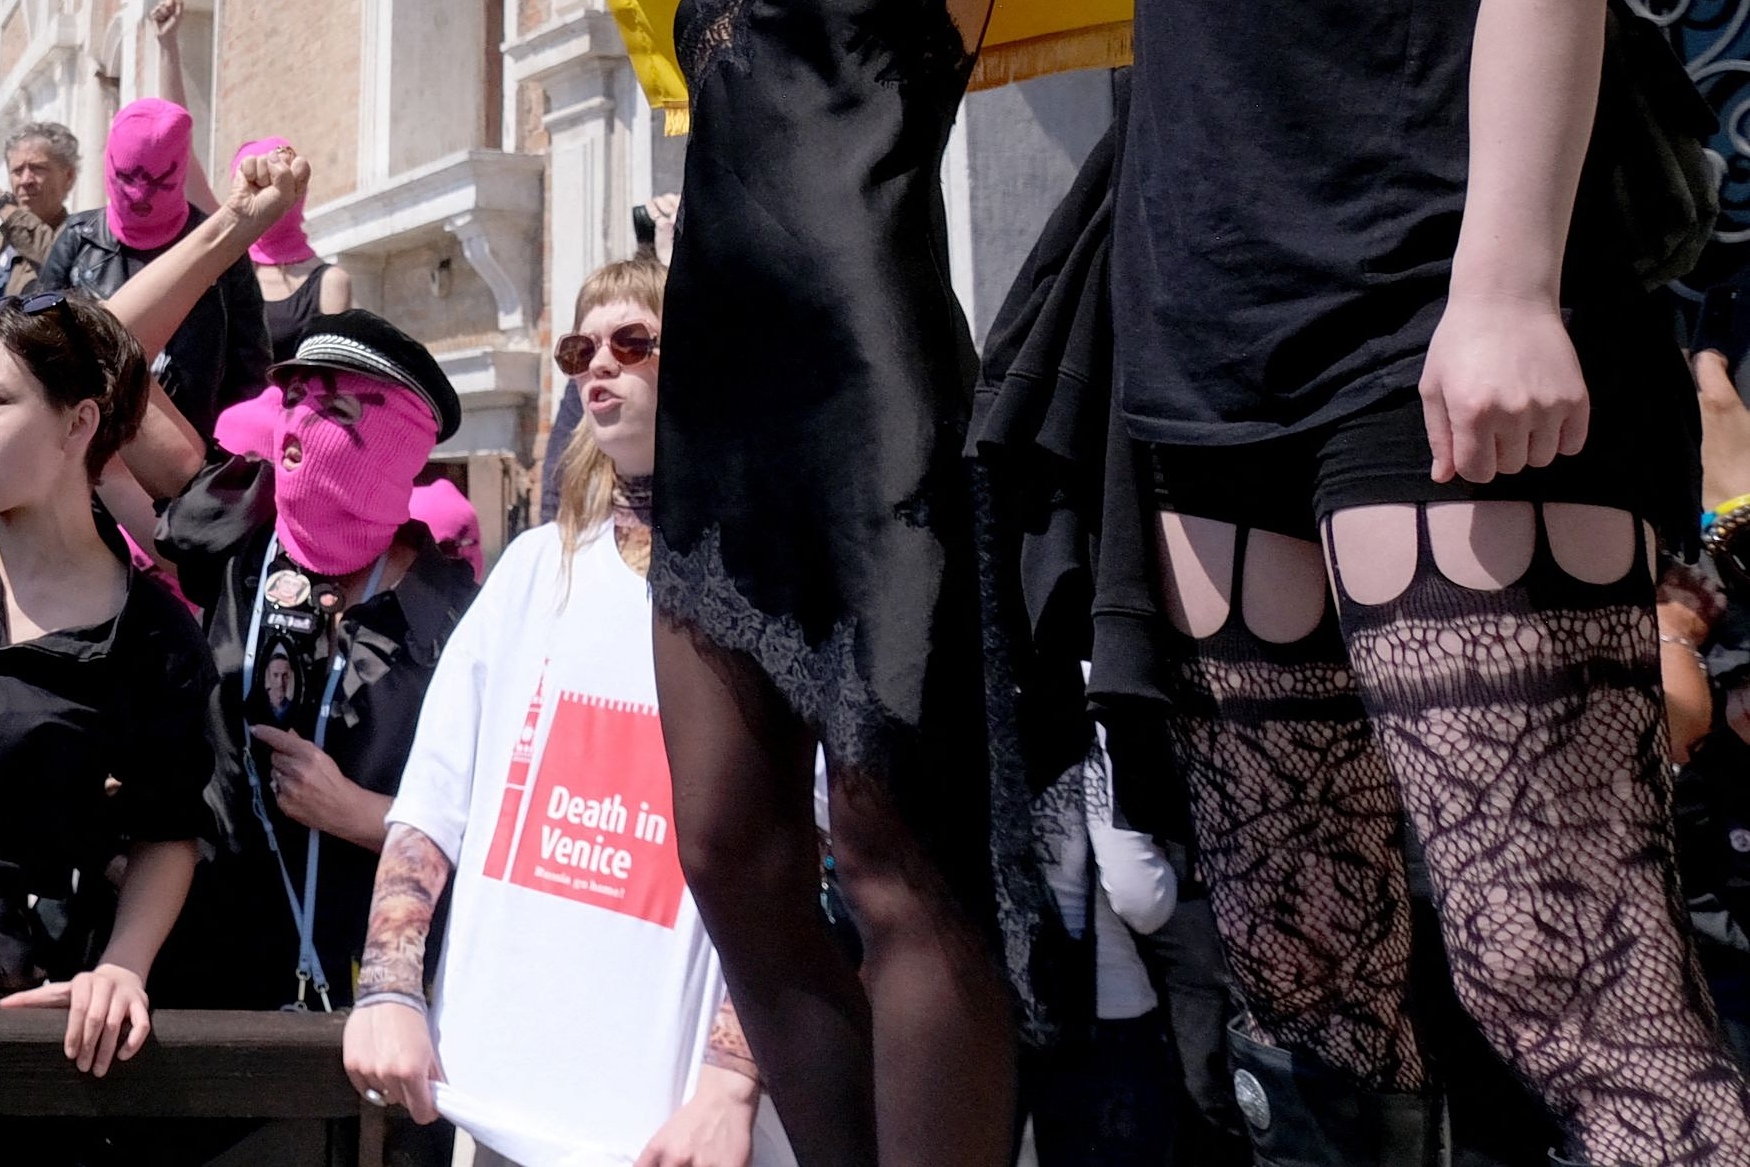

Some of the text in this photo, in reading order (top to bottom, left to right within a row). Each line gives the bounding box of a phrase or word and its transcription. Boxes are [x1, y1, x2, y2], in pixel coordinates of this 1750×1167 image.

[547, 785, 667, 844] Death in
[541, 824, 632, 879] Venice
